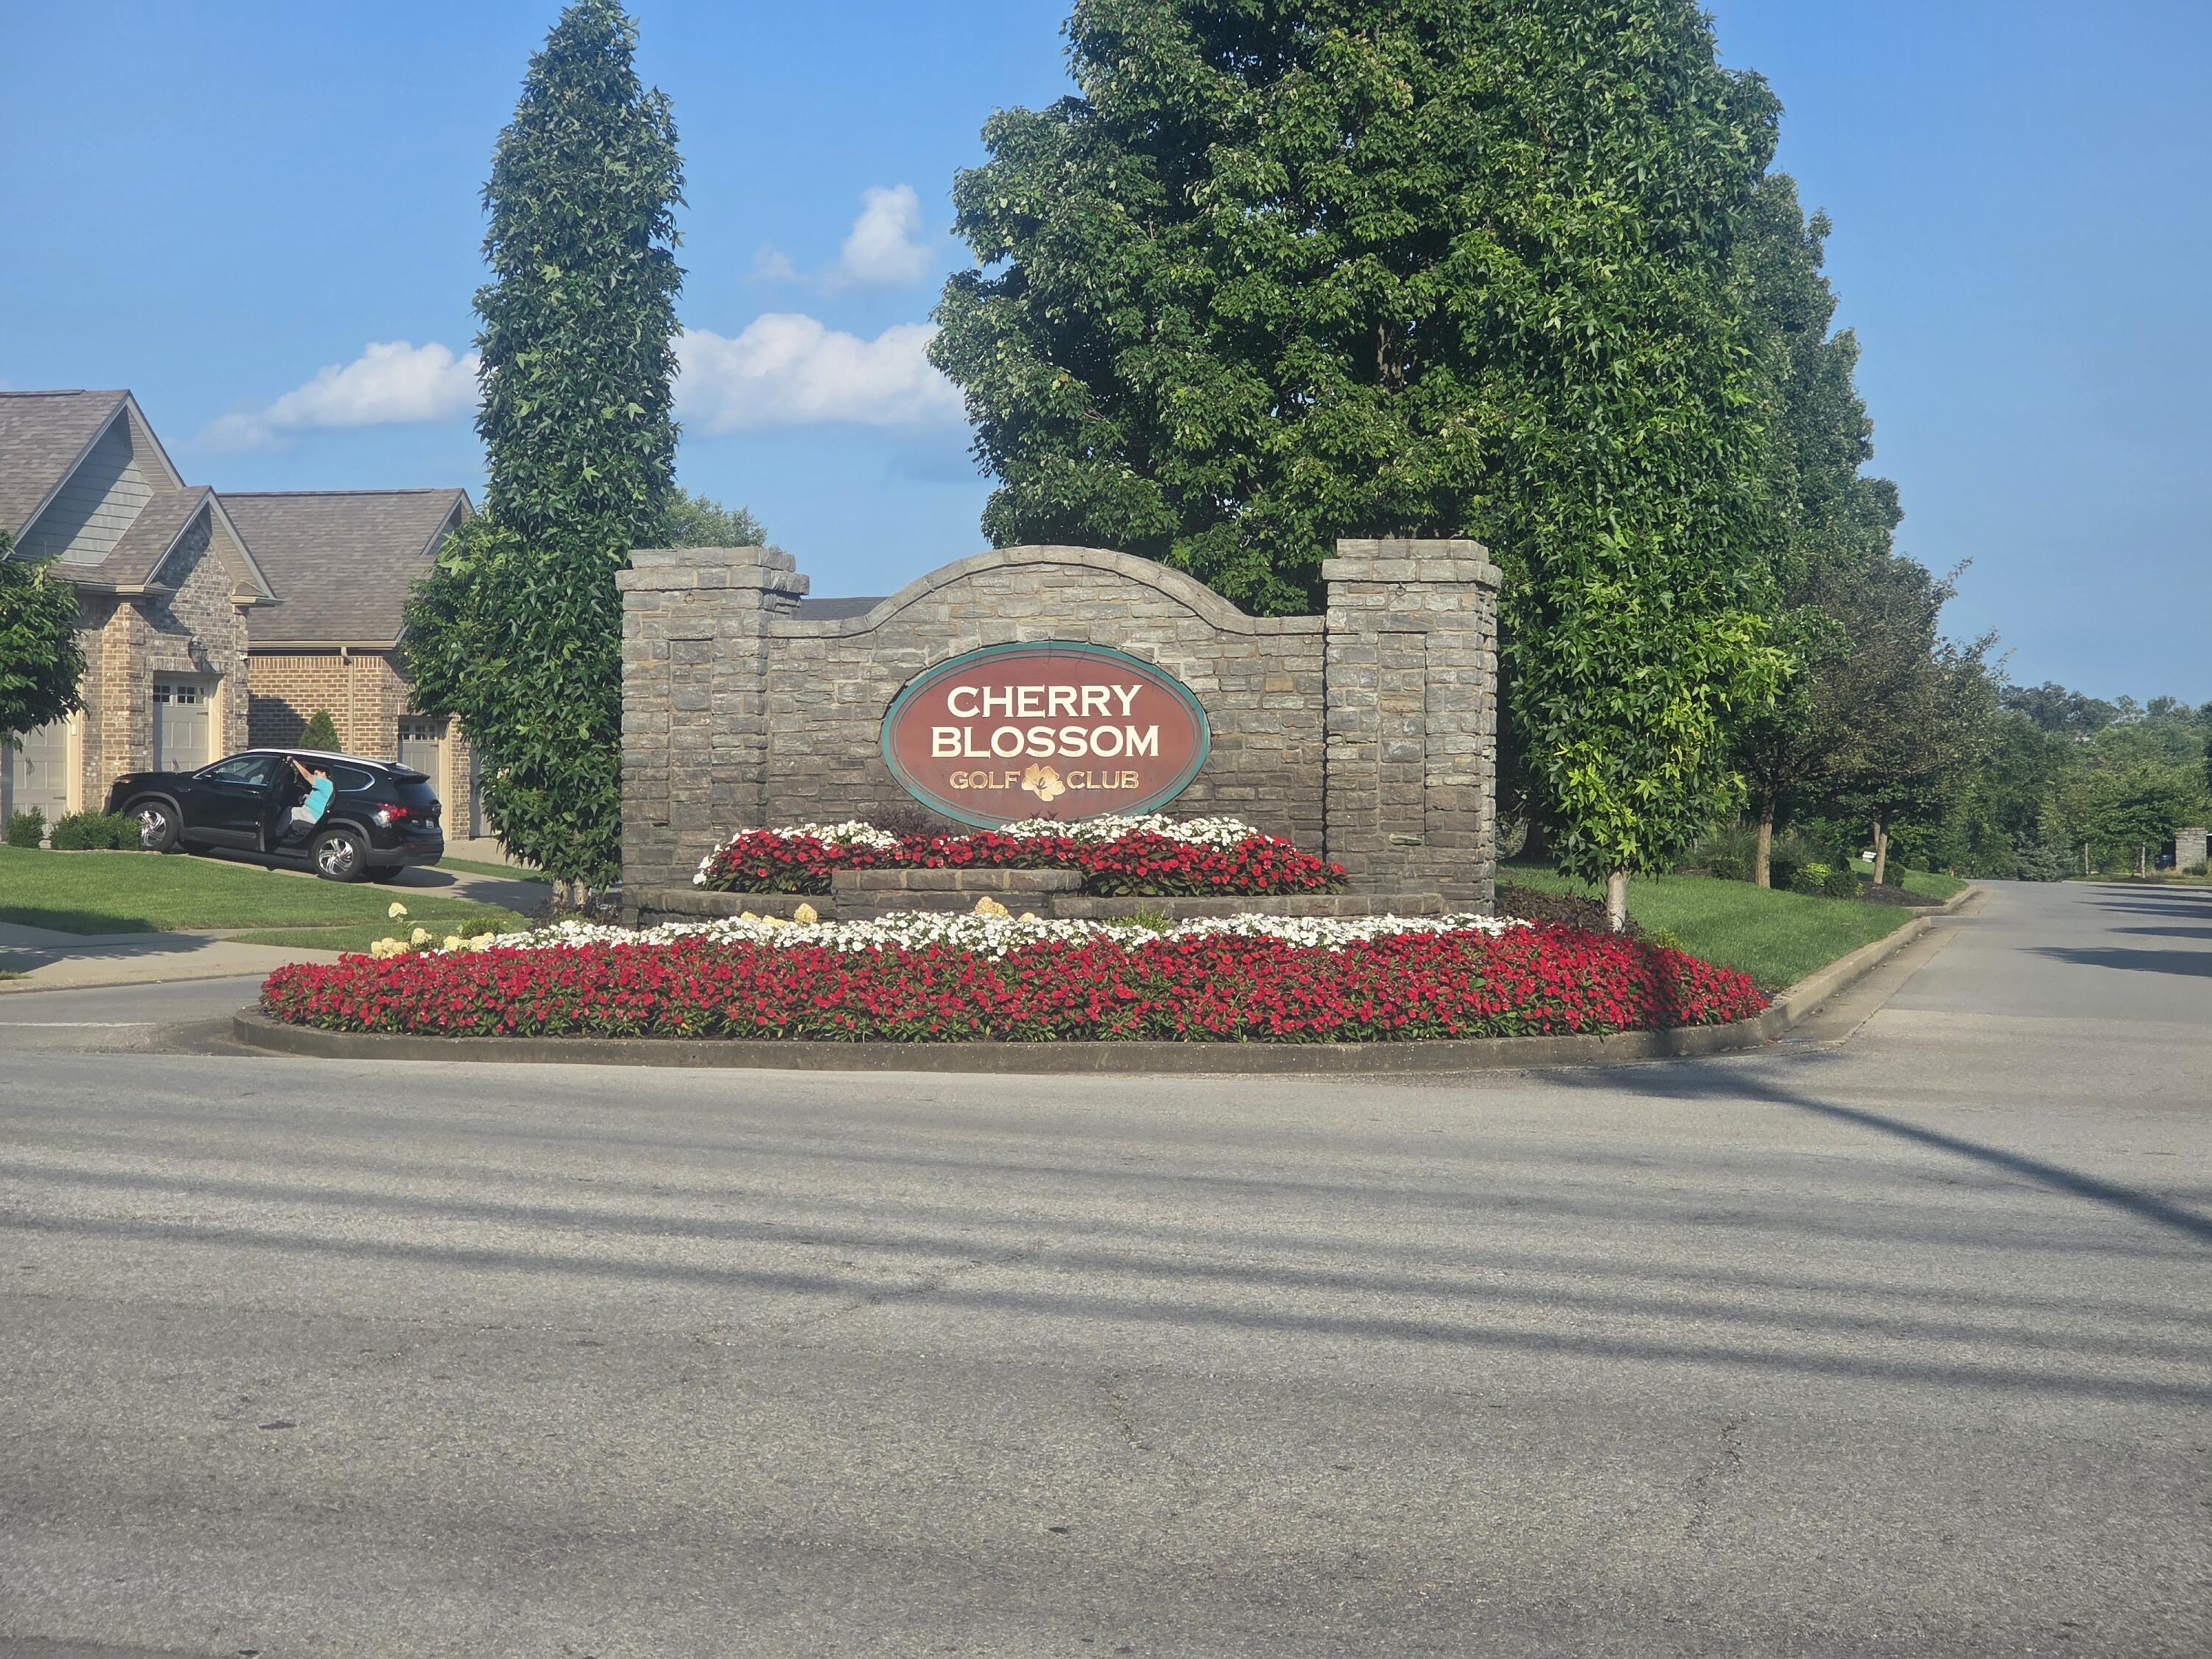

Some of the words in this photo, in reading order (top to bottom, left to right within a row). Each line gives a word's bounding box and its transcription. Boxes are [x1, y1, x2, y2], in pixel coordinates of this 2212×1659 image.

[947, 684, 1143, 718] CHERRY
[931, 725, 1160, 759] BLOSSOM
[949, 771, 1020, 790] GOLF
[1066, 771, 1139, 790] CLUB
